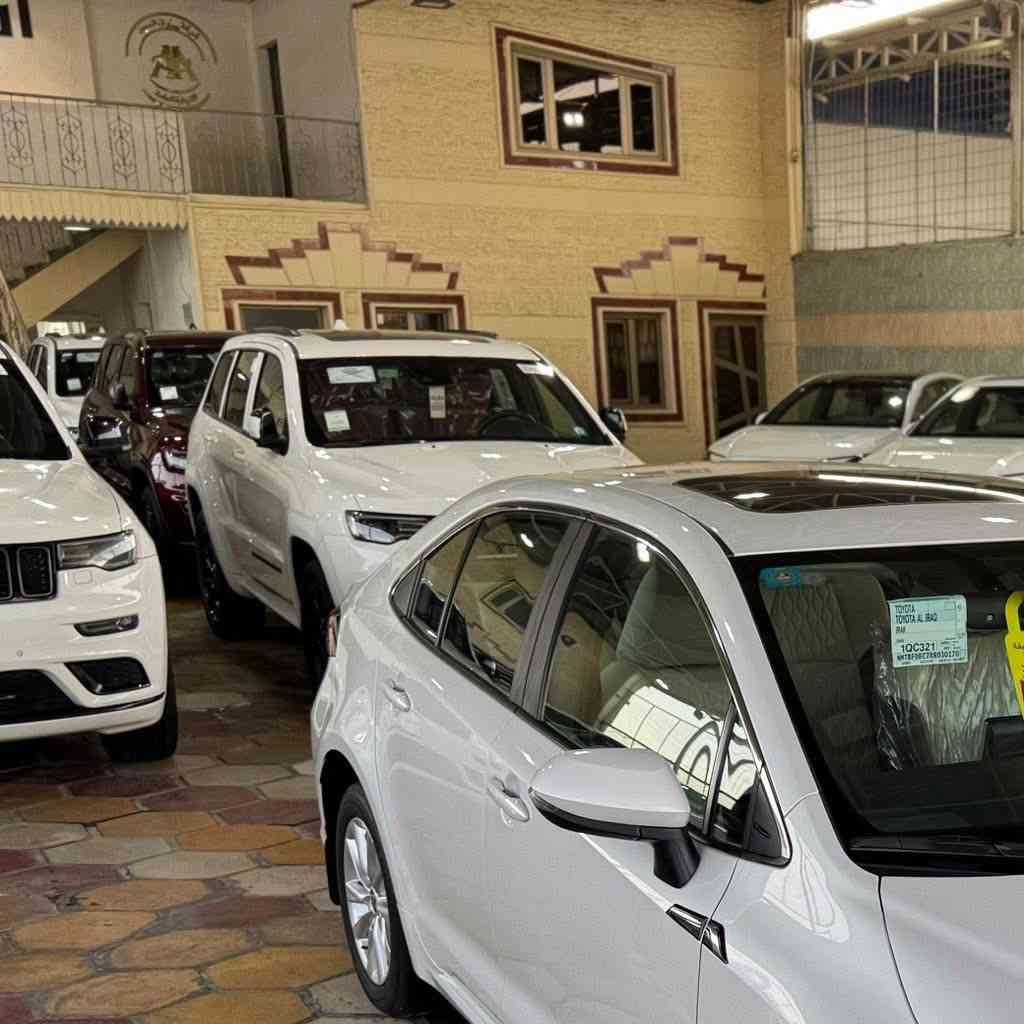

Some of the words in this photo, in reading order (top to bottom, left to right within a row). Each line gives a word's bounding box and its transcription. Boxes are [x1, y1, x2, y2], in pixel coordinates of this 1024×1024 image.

[895, 603, 915, 613] TOYOTA
[895, 614, 915, 624] TOYOTA
[901, 642, 935, 653] 1QC321
